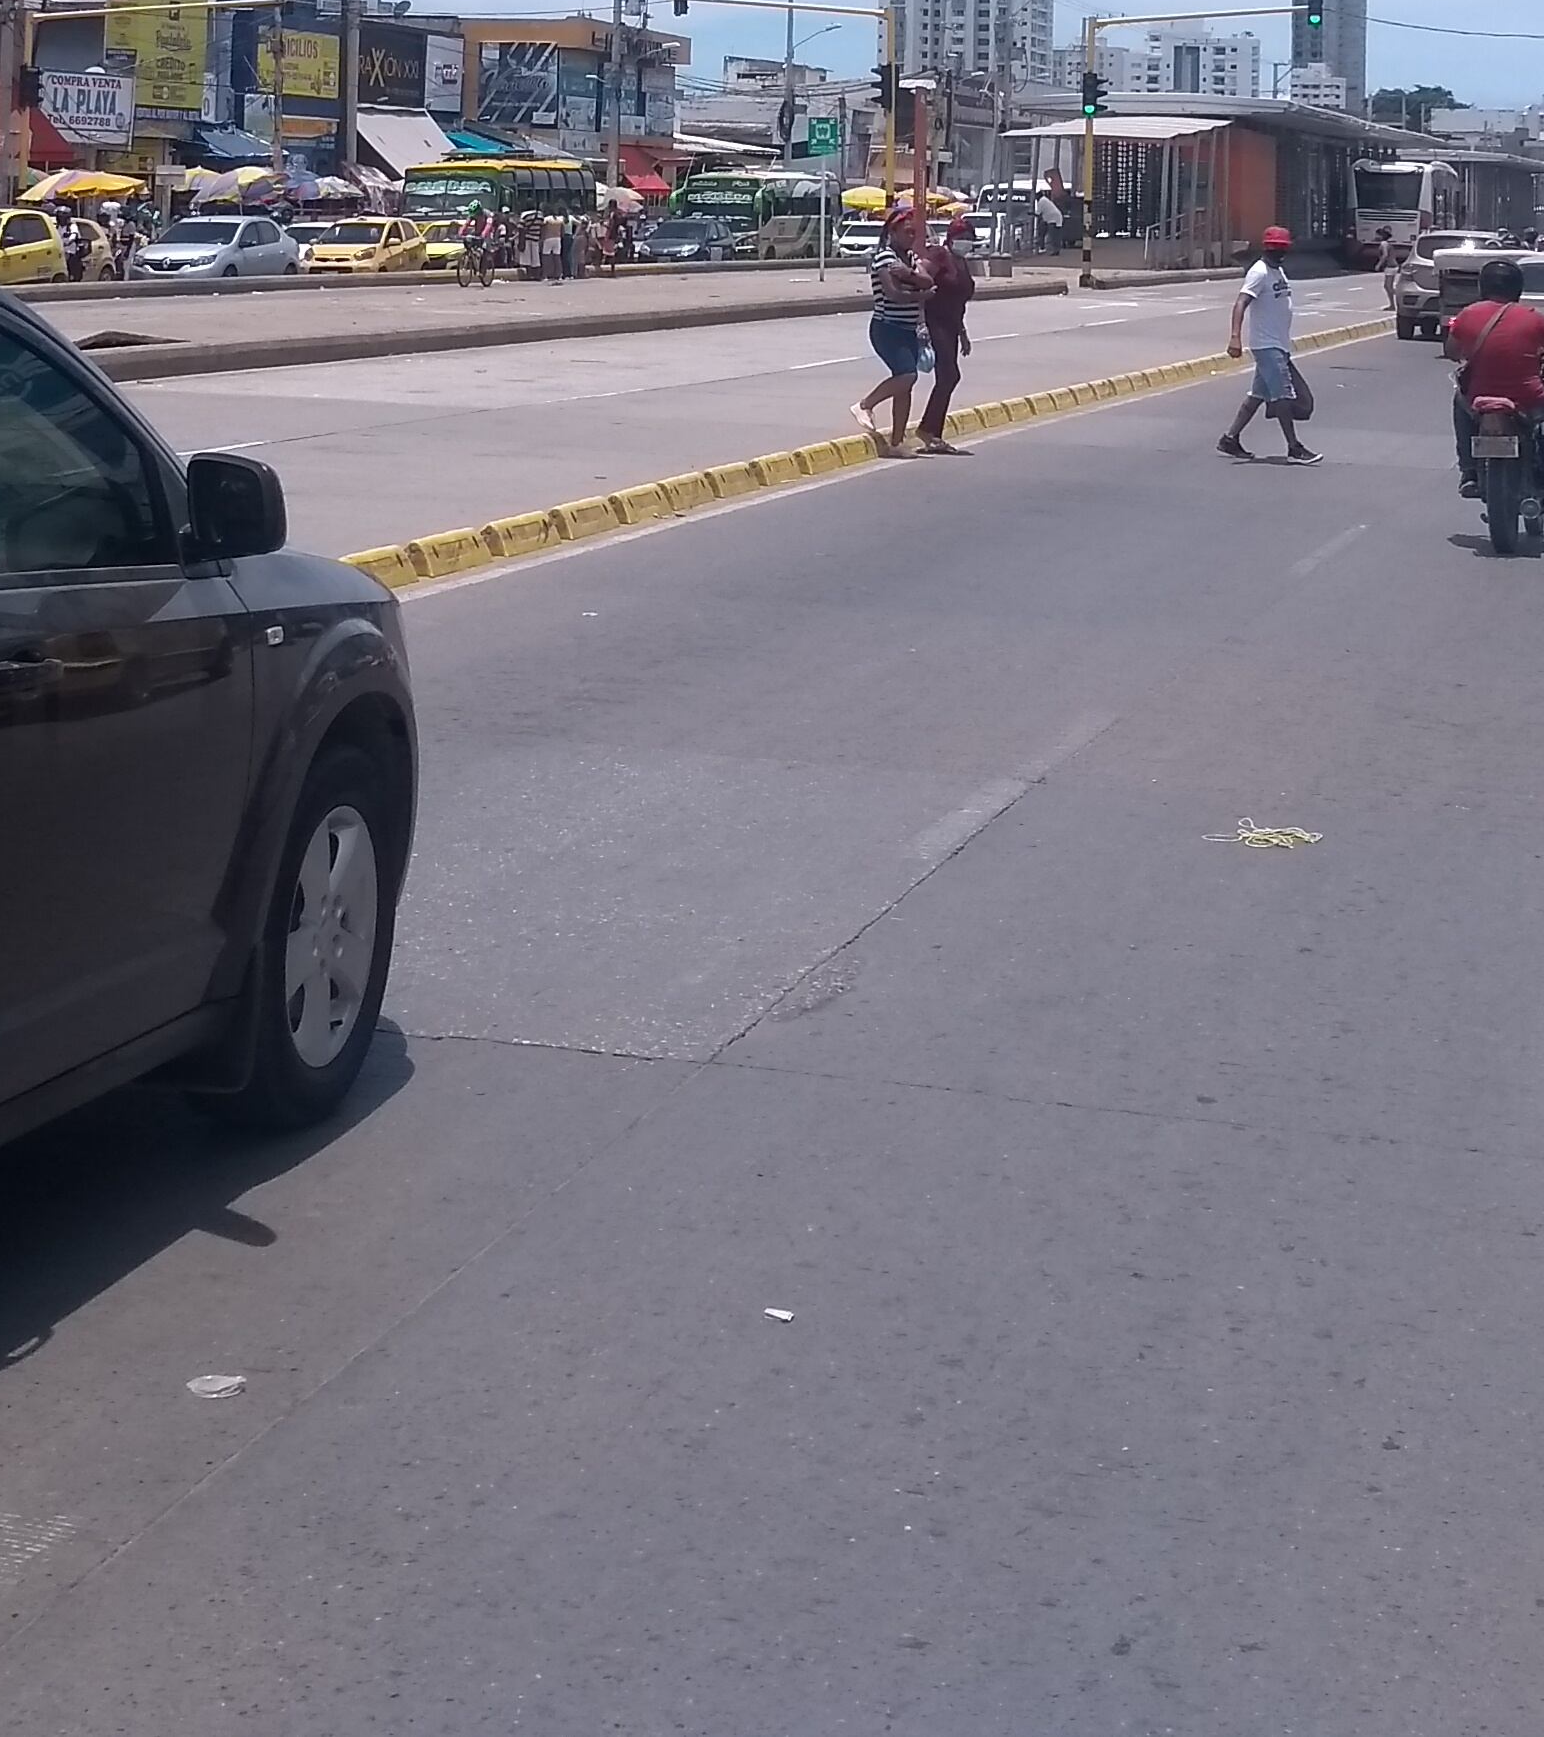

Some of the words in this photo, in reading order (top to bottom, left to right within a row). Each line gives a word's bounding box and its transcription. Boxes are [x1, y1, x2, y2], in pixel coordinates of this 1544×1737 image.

[51, 74, 90, 88] COMPRA
[92, 77, 122, 90] VENTA
[53, 87, 69, 113] LA
[76, 89, 117, 115] PLAYA
